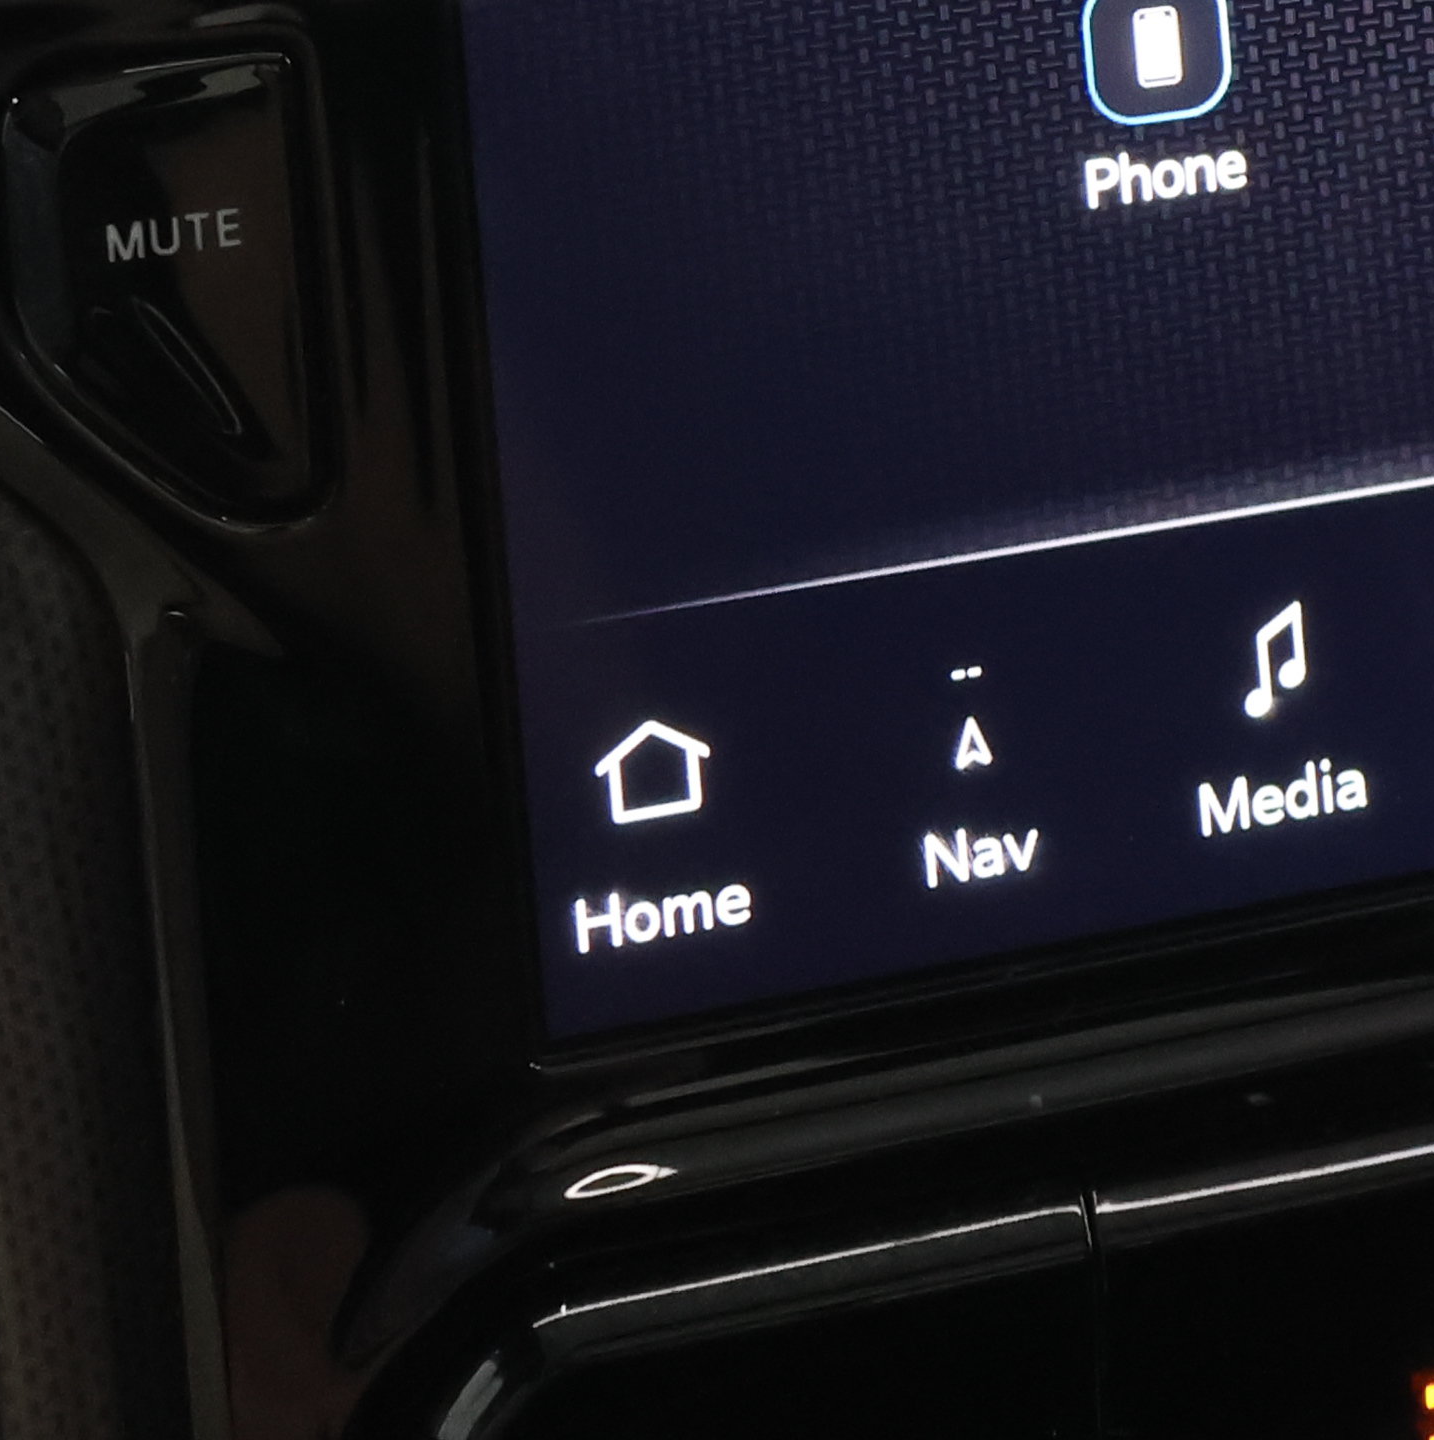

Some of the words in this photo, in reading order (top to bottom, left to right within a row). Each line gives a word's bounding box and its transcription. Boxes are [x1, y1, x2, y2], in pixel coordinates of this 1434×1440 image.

[1085, 145, 1248, 208] Phone
[105, 209, 240, 263] MUTE
[1197, 758, 1368, 836] Media
[923, 825, 1038, 888] Nav
[573, 881, 752, 954] Home
